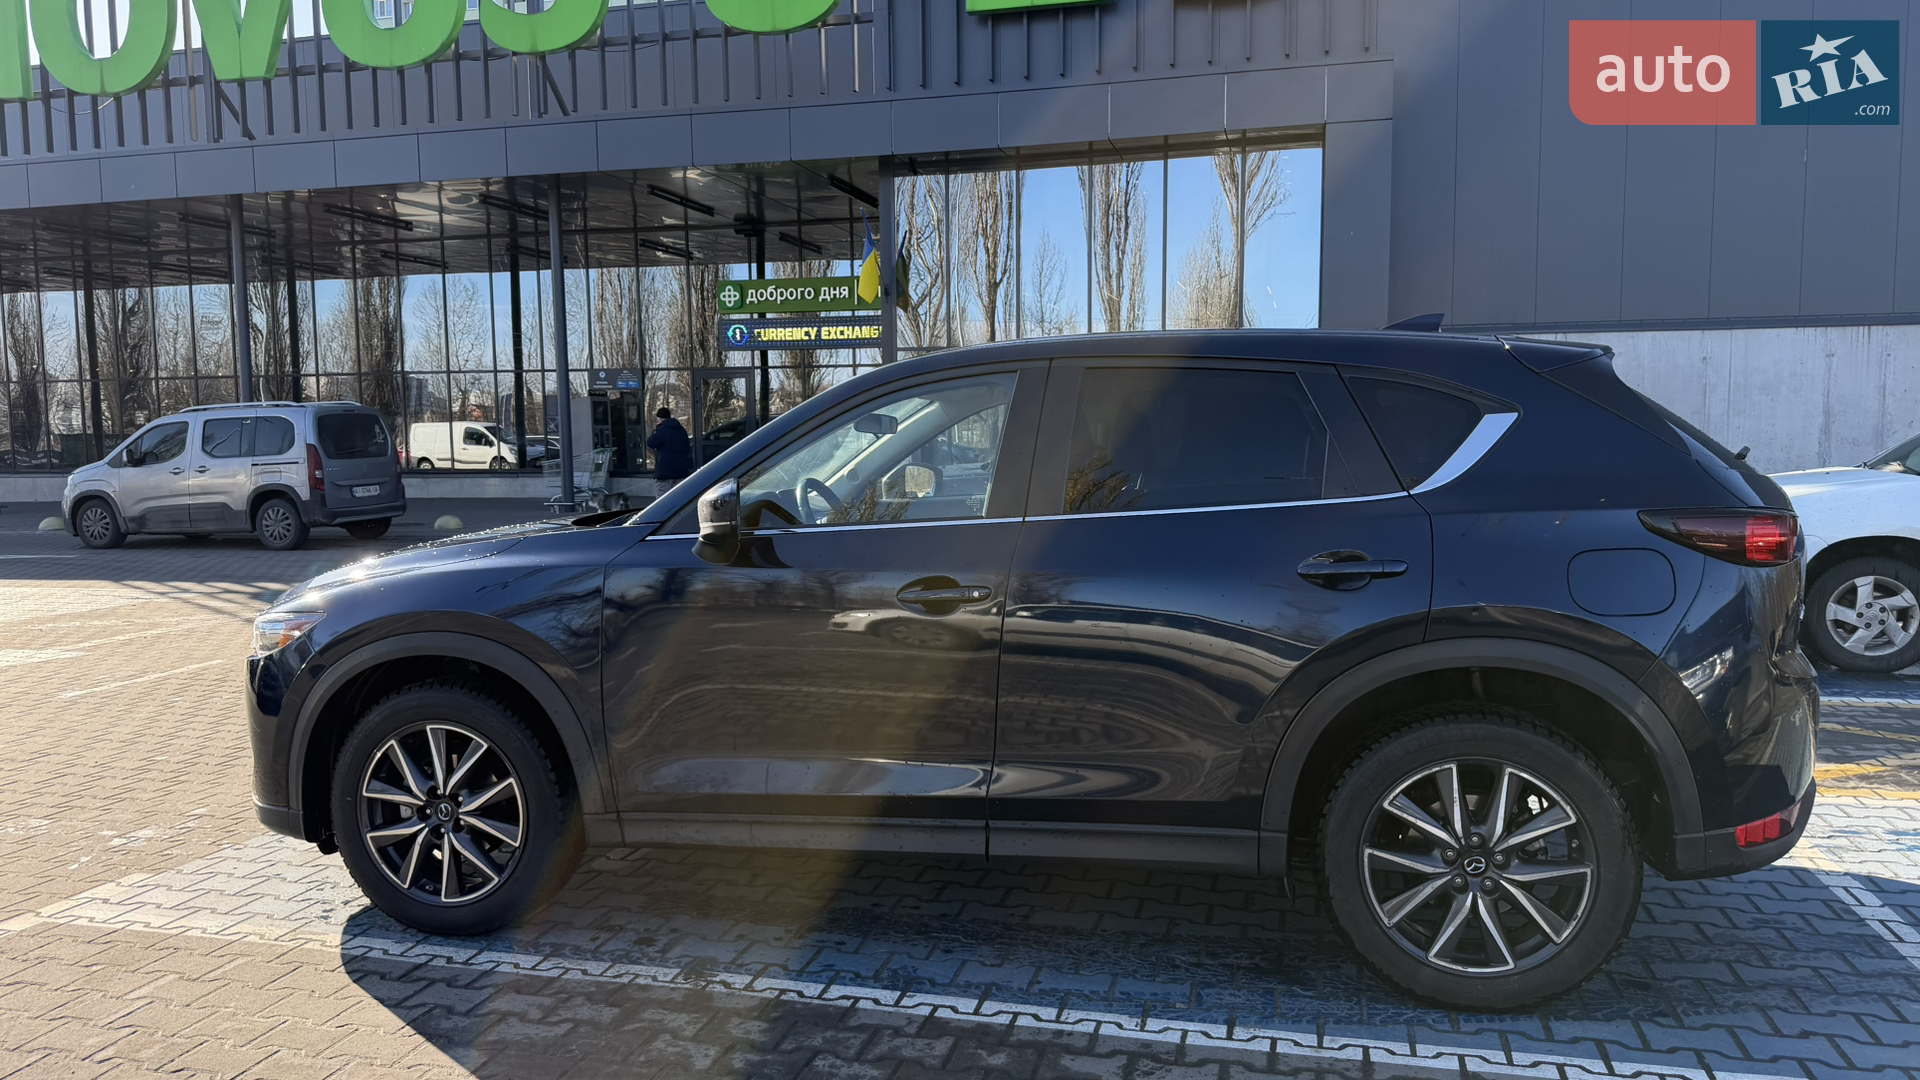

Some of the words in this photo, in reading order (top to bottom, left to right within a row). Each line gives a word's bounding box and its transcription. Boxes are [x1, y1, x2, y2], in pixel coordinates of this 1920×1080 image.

[746, 285, 815, 304] доброго
[819, 286, 849, 302] дня
[754, 327, 819, 341] CURRENCY
[821, 325, 882, 340] EXCHANG
